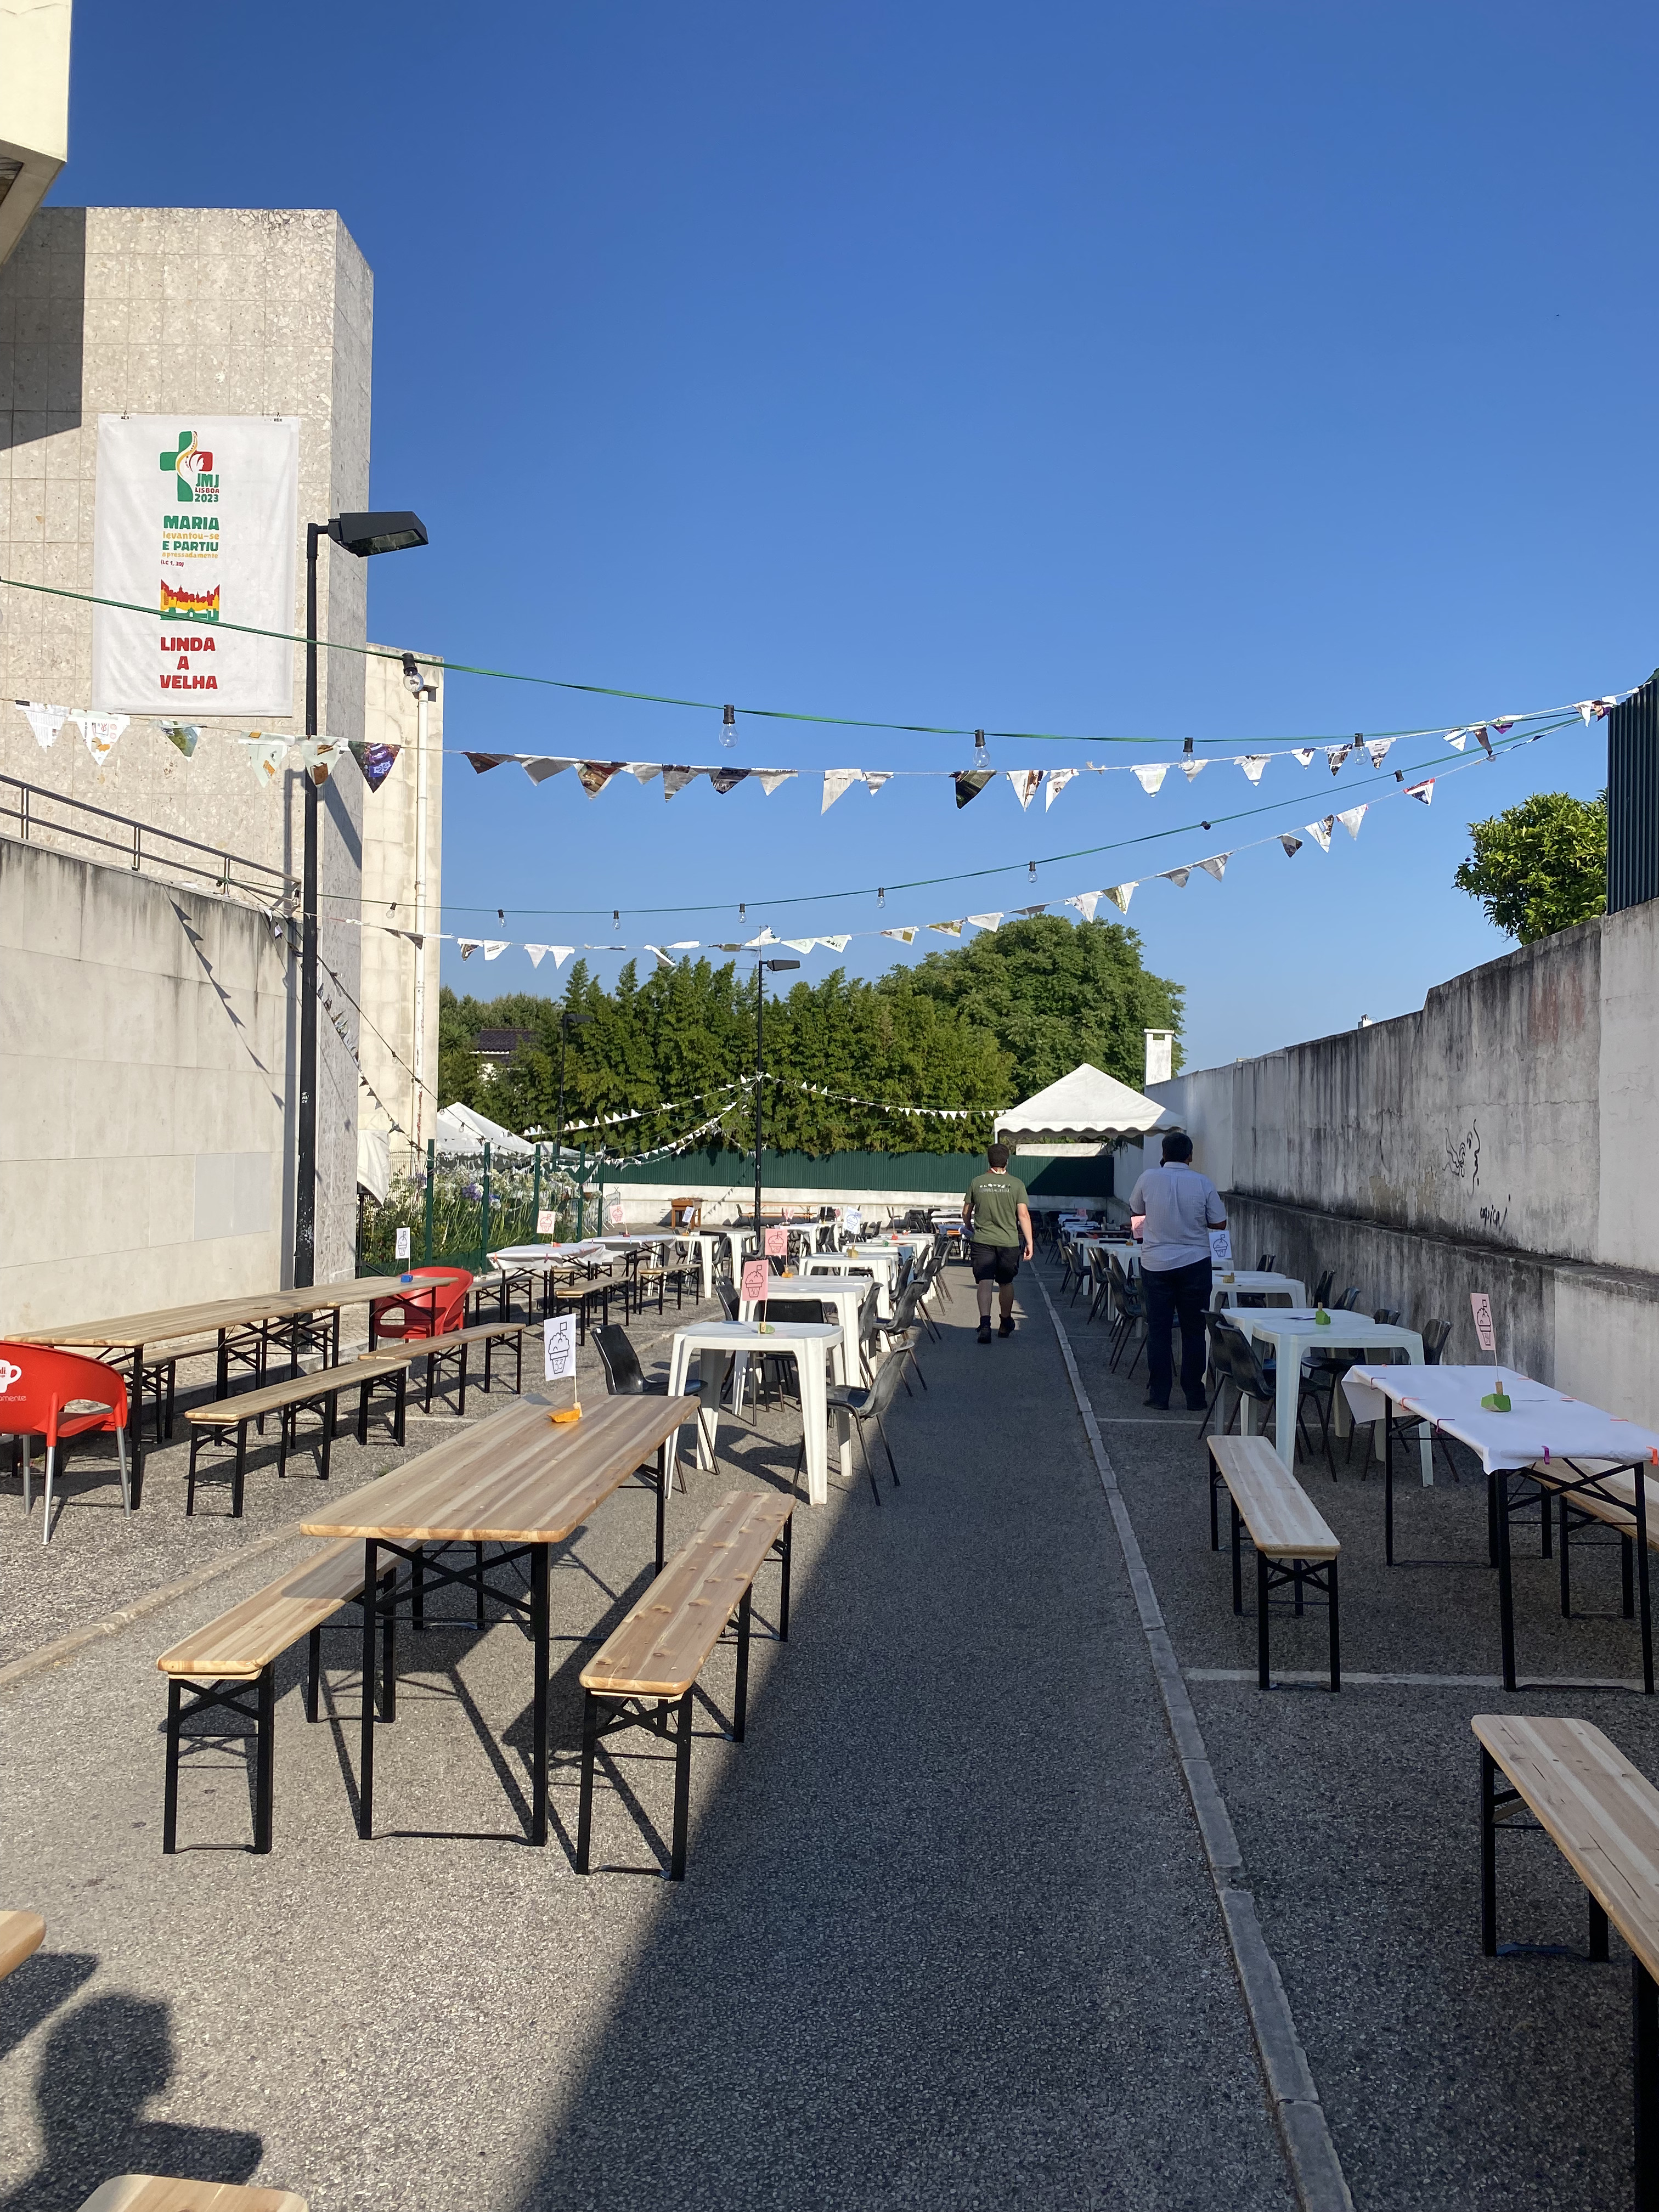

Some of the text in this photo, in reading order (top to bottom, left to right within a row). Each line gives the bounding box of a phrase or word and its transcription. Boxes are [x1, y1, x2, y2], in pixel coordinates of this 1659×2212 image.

[196, 473, 219, 488] JMJ
[195, 494, 219, 503] 2023
[163, 515, 219, 531] MARIA
[162, 531, 219, 539] levantou-se
[162, 540, 219, 551] E PARTIU
[161, 636, 216, 651] LINDA
[177, 656, 189, 670] A
[160, 675, 218, 689] VELHA
[555, 1358, 563, 1372] 33
